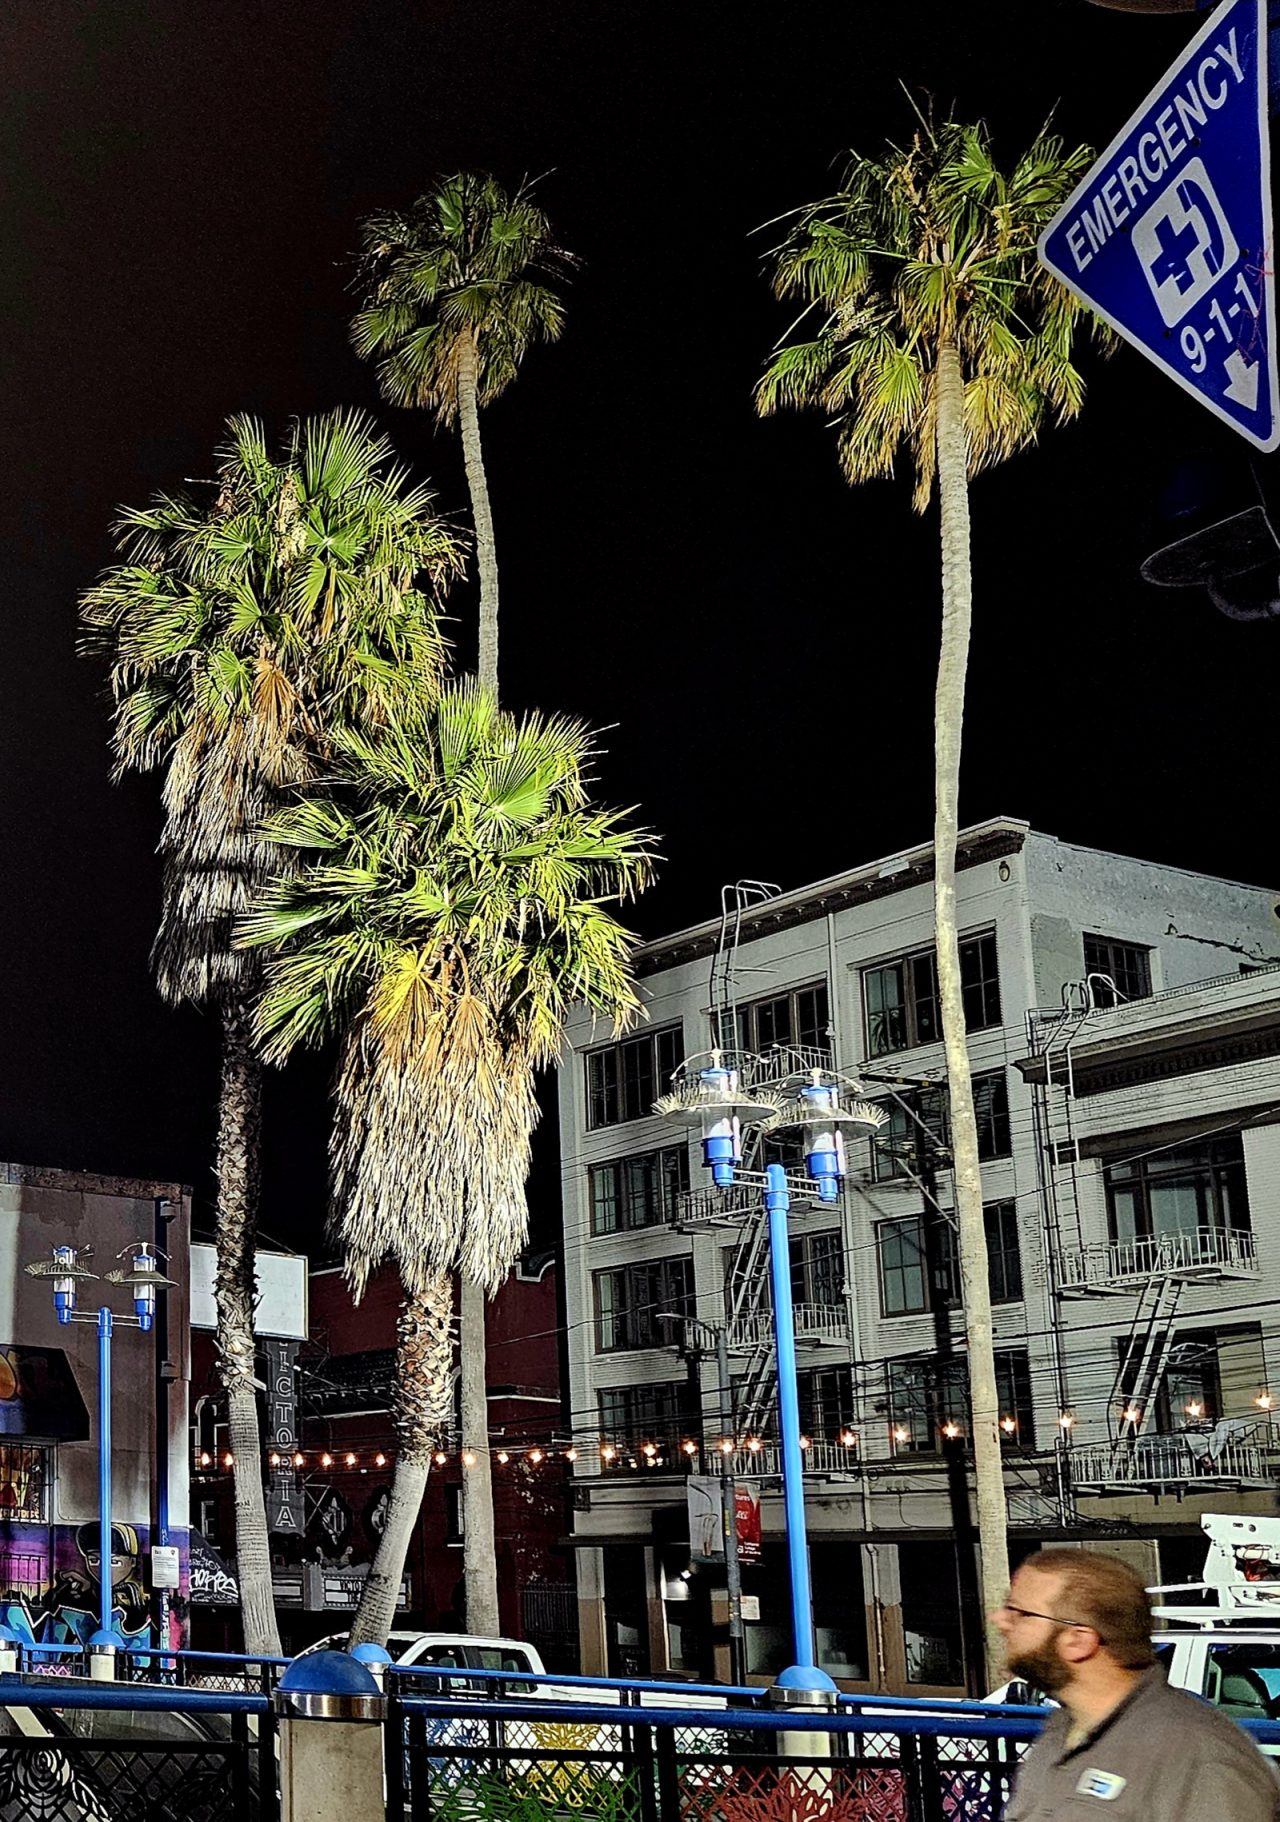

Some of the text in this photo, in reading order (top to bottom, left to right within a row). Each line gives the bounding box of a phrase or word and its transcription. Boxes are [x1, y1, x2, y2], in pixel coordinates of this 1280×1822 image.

[1065, 28, 1244, 273] EMERGENCY
[1180, 272, 1259, 374] 9-1-1
[275, 1341, 297, 1528] ICTORIA
